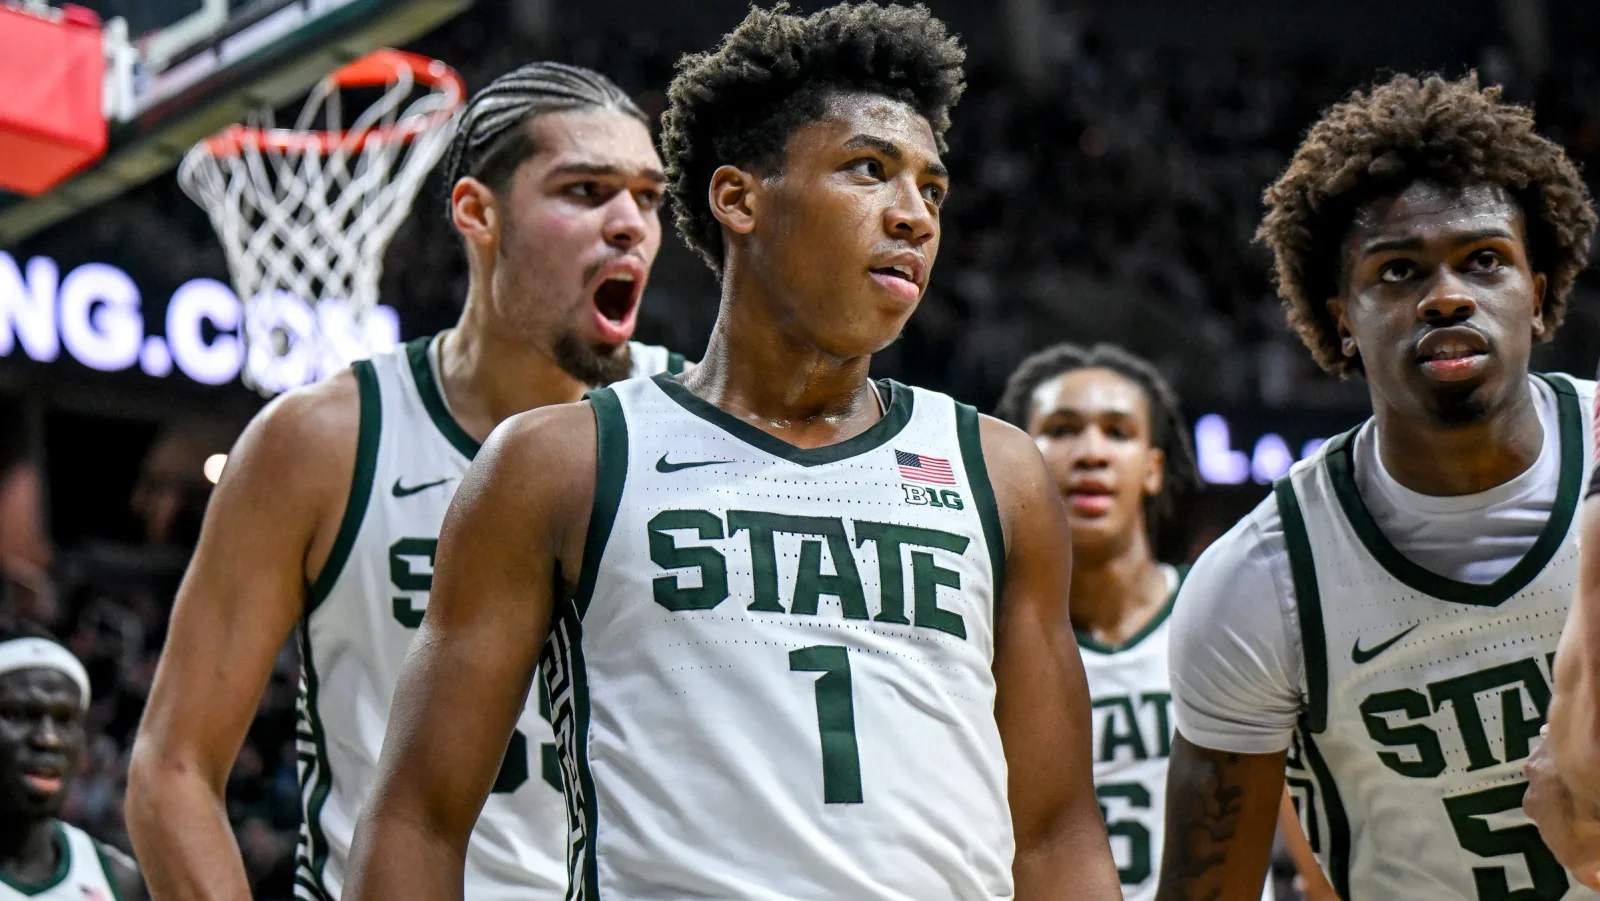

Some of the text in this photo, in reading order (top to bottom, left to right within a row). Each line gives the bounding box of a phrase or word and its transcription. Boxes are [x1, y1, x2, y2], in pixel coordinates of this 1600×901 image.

[647, 509, 971, 640] STATE
[789, 645, 863, 804] 1
[1359, 651, 1556, 778] STA
